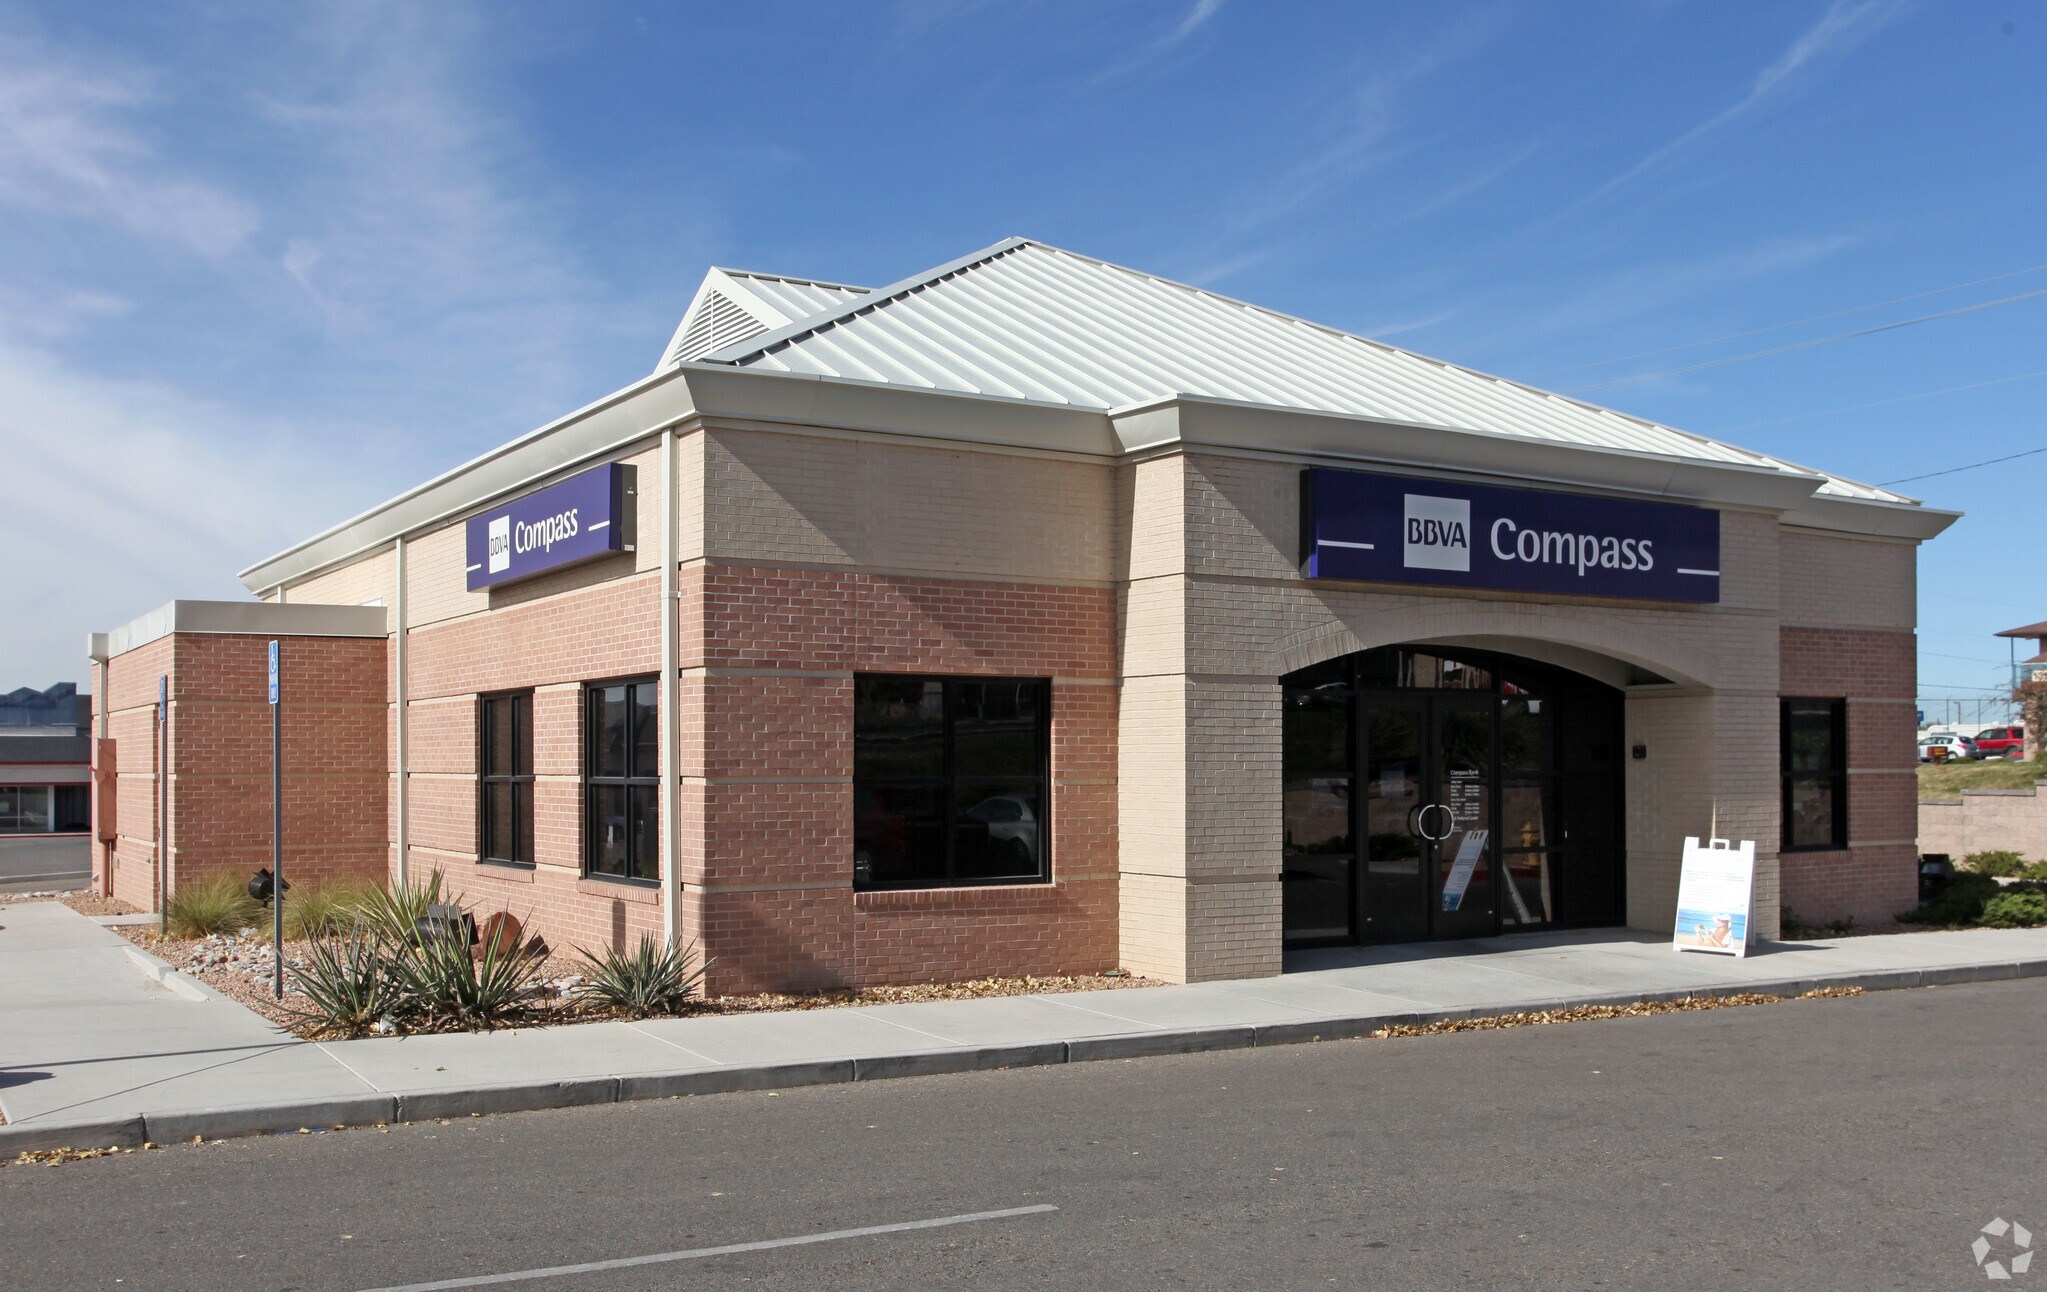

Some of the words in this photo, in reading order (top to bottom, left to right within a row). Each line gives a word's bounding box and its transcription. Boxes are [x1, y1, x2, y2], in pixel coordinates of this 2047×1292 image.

[490, 534, 509, 556] BBVA
[515, 508, 578, 554] Compass
[1407, 518, 1467, 548] BBVA
[1490, 517, 1654, 576] Compass
